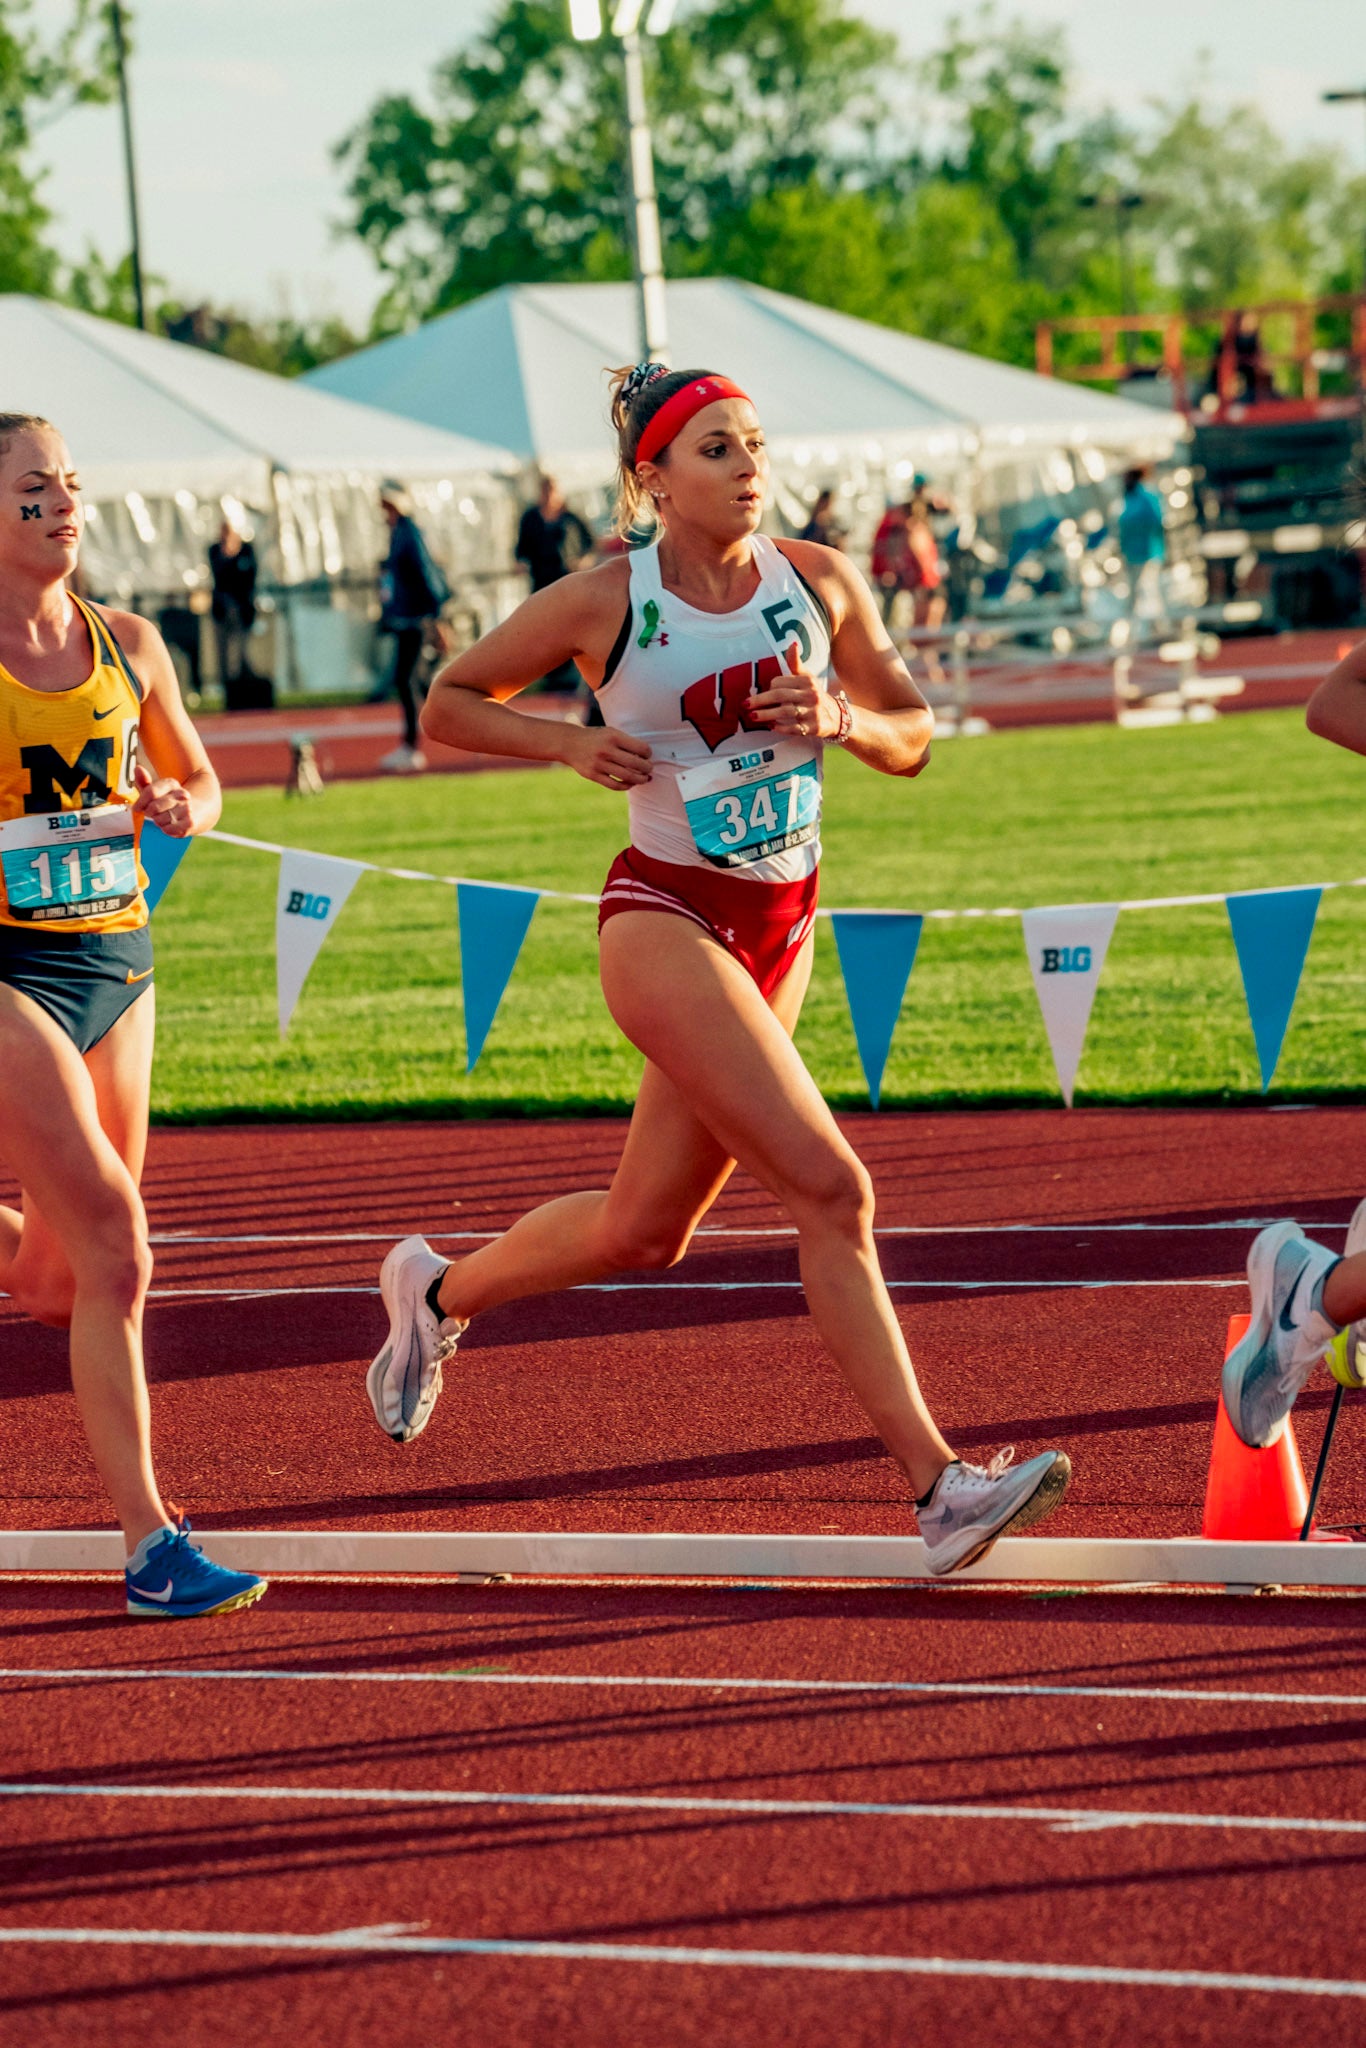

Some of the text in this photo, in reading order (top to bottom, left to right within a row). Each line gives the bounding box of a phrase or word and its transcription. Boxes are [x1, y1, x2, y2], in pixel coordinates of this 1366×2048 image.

[20, 504, 42, 520] M
[761, 598, 812, 664] 5
[20, 736, 114, 814] M
[714, 774, 801, 845] 347
[30, 845, 115, 900] 115
